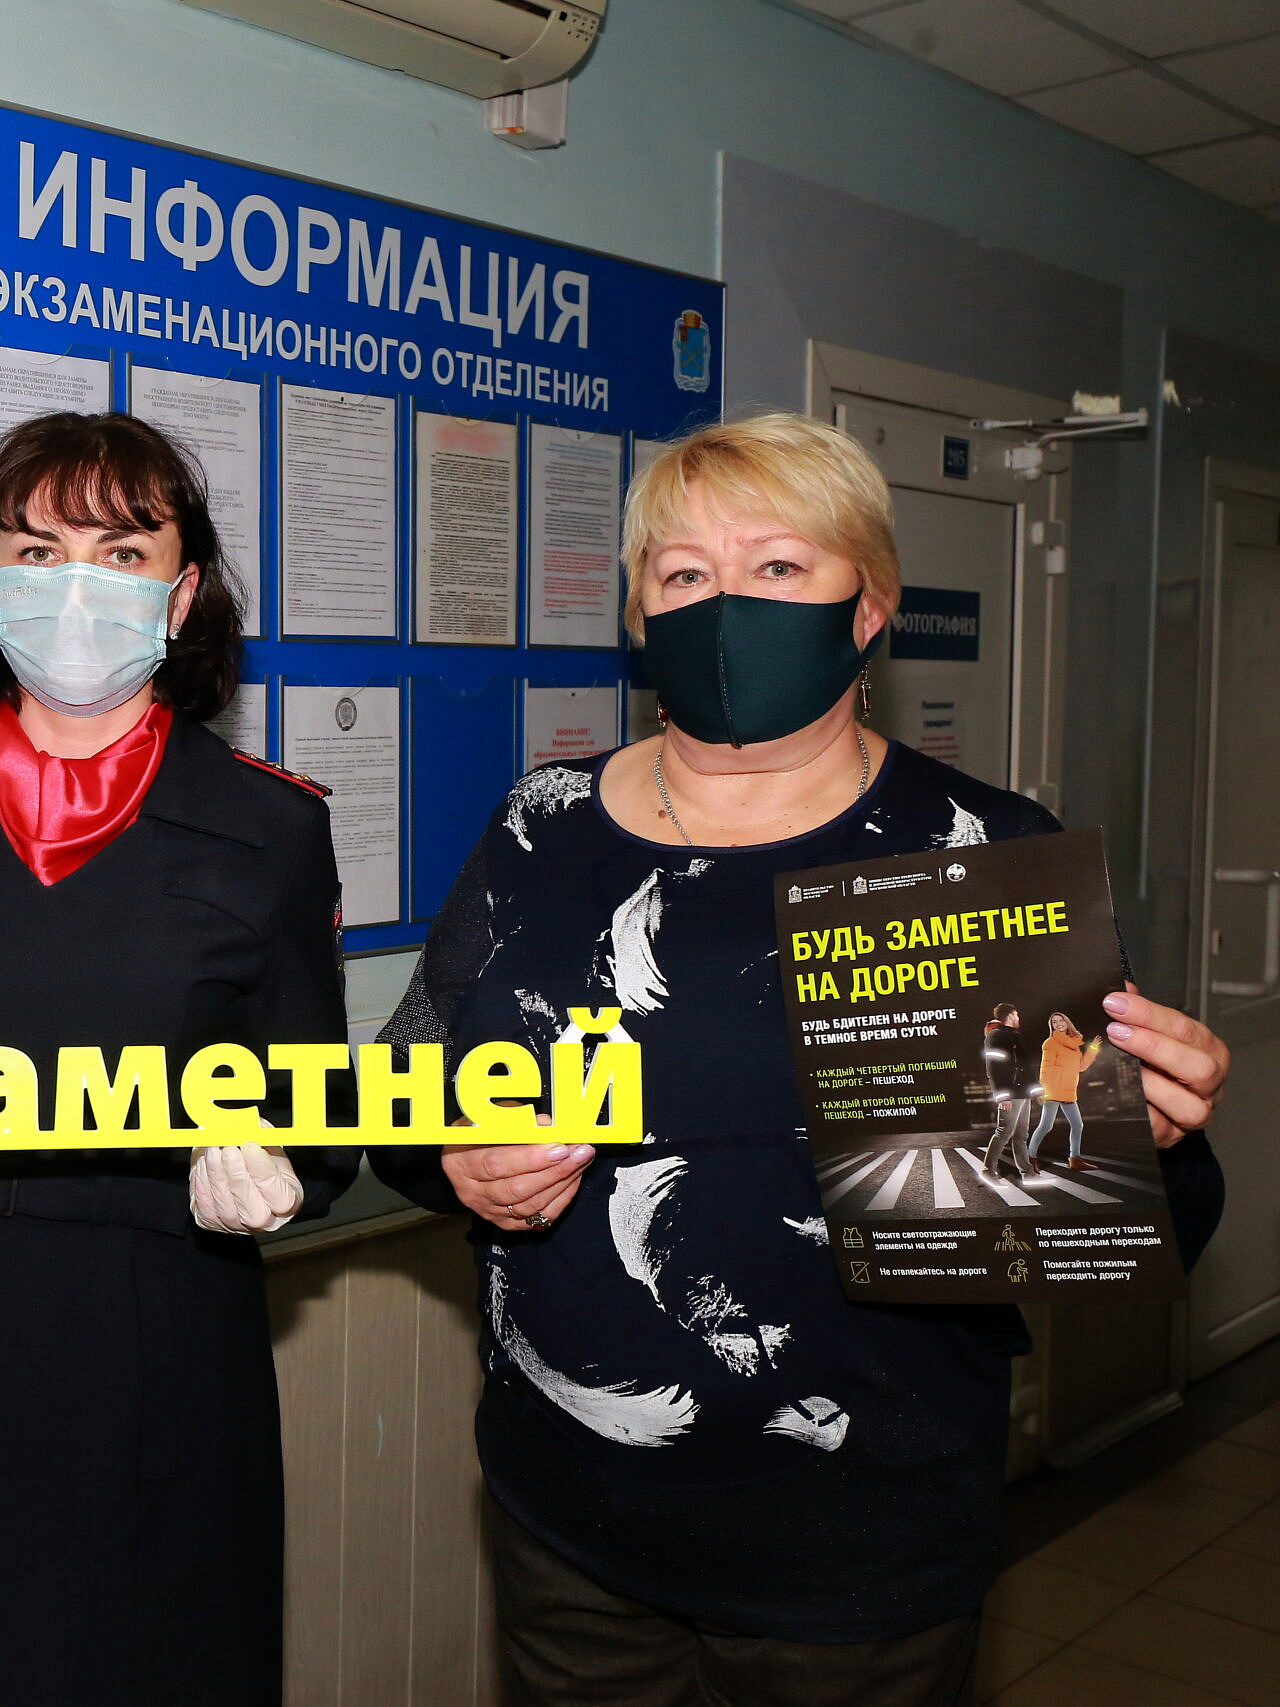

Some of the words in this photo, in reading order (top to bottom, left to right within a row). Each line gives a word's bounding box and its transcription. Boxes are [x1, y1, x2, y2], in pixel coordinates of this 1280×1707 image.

[19, 141, 589, 349] ИНФОРМАЦИЯ
[431, 346, 609, 412] ОТДЕЛЕНИЯ
[893, 612, 976, 635] ФОТОГРАФИЯ
[791, 925, 875, 963] БУДЬ
[885, 901, 1069, 951] ЗАМЕТНЕЕ
[795, 971, 840, 1003] НА
[849, 956, 979, 1003] ДОРОГЕ
[802, 1019, 830, 1032] БУДЬ
[833, 1013, 890, 1030] БДИТЕЛЕН
[893, 1011, 909, 1025] НА
[912, 1008, 957, 1024] ДОРОГЕ
[804, 1035, 812, 1046] В
[814, 1030, 858, 1045] ТЕМНОЕ
[860, 1027, 897, 1042] ВРЕМЯ
[900, 1024, 938, 1039] СУТОК
[816, 1067, 854, 1078] КАЖДЫЙ
[857, 1063, 906, 1074] ЧЕТВЕРТЫЙ
[909, 1059, 957, 1071] ПОГИБШИЙ
[818, 1080, 830, 1088] НА
[832, 1078, 863, 1088] ДОРОГЕ
[873, 1075, 914, 1085] ПЕШЕХОД
[822, 1099, 860, 1109] КАЖДЫЙ
[863, 1097, 895, 1107] ВТОРОЙ
[898, 1094, 946, 1104] ПОГИБШИЙ
[824, 1110, 864, 1120] ПЕШЕХОД
[873, 1106, 917, 1117] ПОЖИЛОЙ
[872, 1230, 900, 1240] Носите
[902, 1229, 977, 1240] светоотражающие
[1036, 1227, 1088, 1238] Переходите
[1090, 1226, 1120, 1237] дорогу
[1122, 1224, 1155, 1234] только
[875, 1242, 914, 1251] элементы
[916, 1241, 925, 1249] на
[927, 1241, 958, 1251] одежде
[1038, 1240, 1049, 1248] по
[1051, 1238, 1109, 1248] пешеходным
[1111, 1236, 1161, 1247] переходам
[1043, 1259, 1091, 1269] Помогайте
[1093, 1260, 1137, 1268] пожилым
[880, 1268, 890, 1276] Не
[892, 1266, 945, 1276] отвлекайтесь
[959, 1267, 987, 1277] дороге
[1046, 1272, 1097, 1282] переходить
[1099, 1270, 1130, 1281] дорогу
